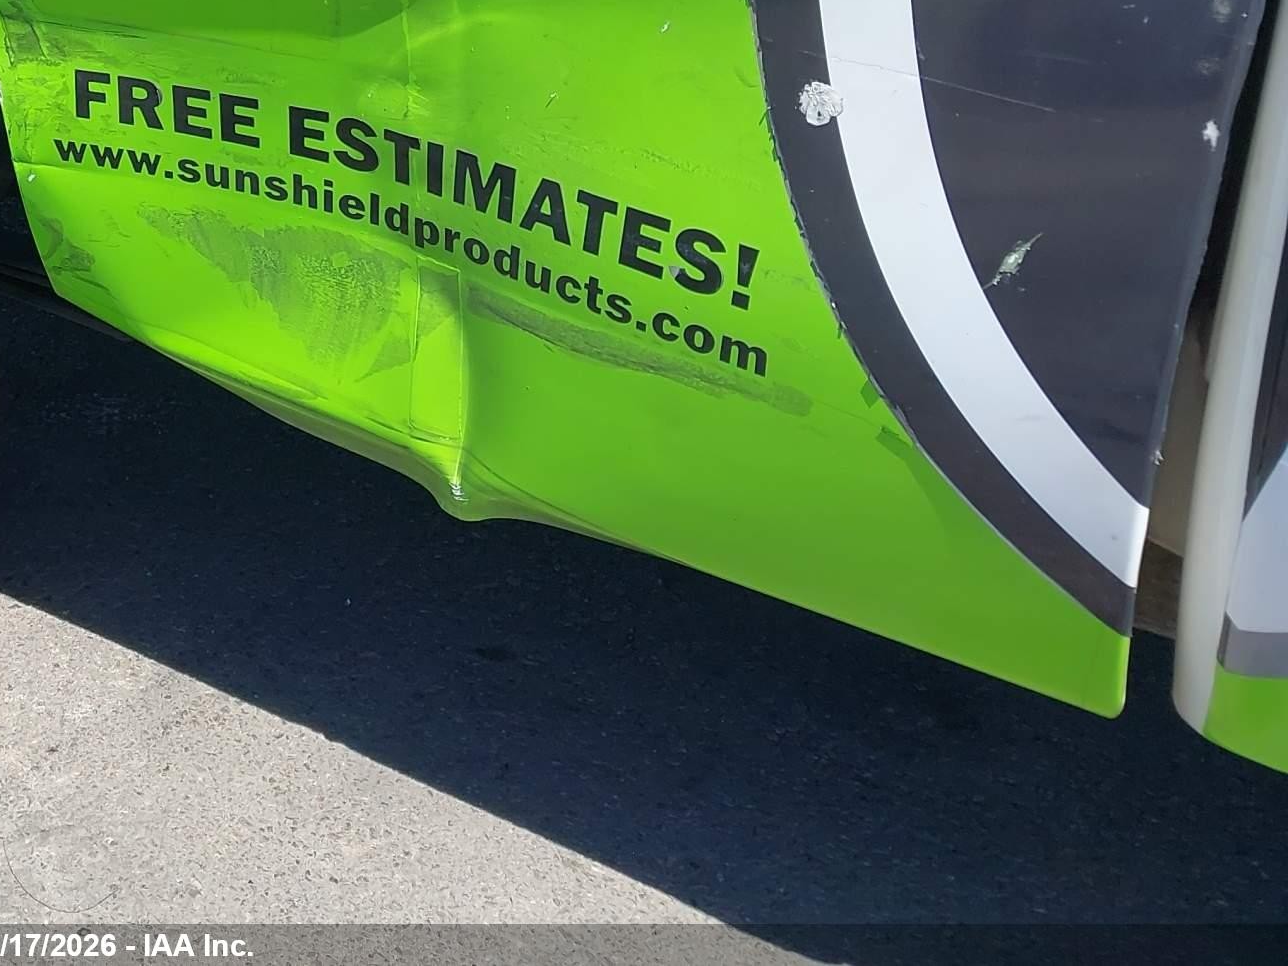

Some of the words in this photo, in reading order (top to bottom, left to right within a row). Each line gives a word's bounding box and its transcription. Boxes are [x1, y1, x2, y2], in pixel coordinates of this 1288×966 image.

[52, 136, 769, 377] www.sunshieldproducts.com
[73, 69, 262, 149] FREE
[288, 105, 761, 311] ESTIMATES!
